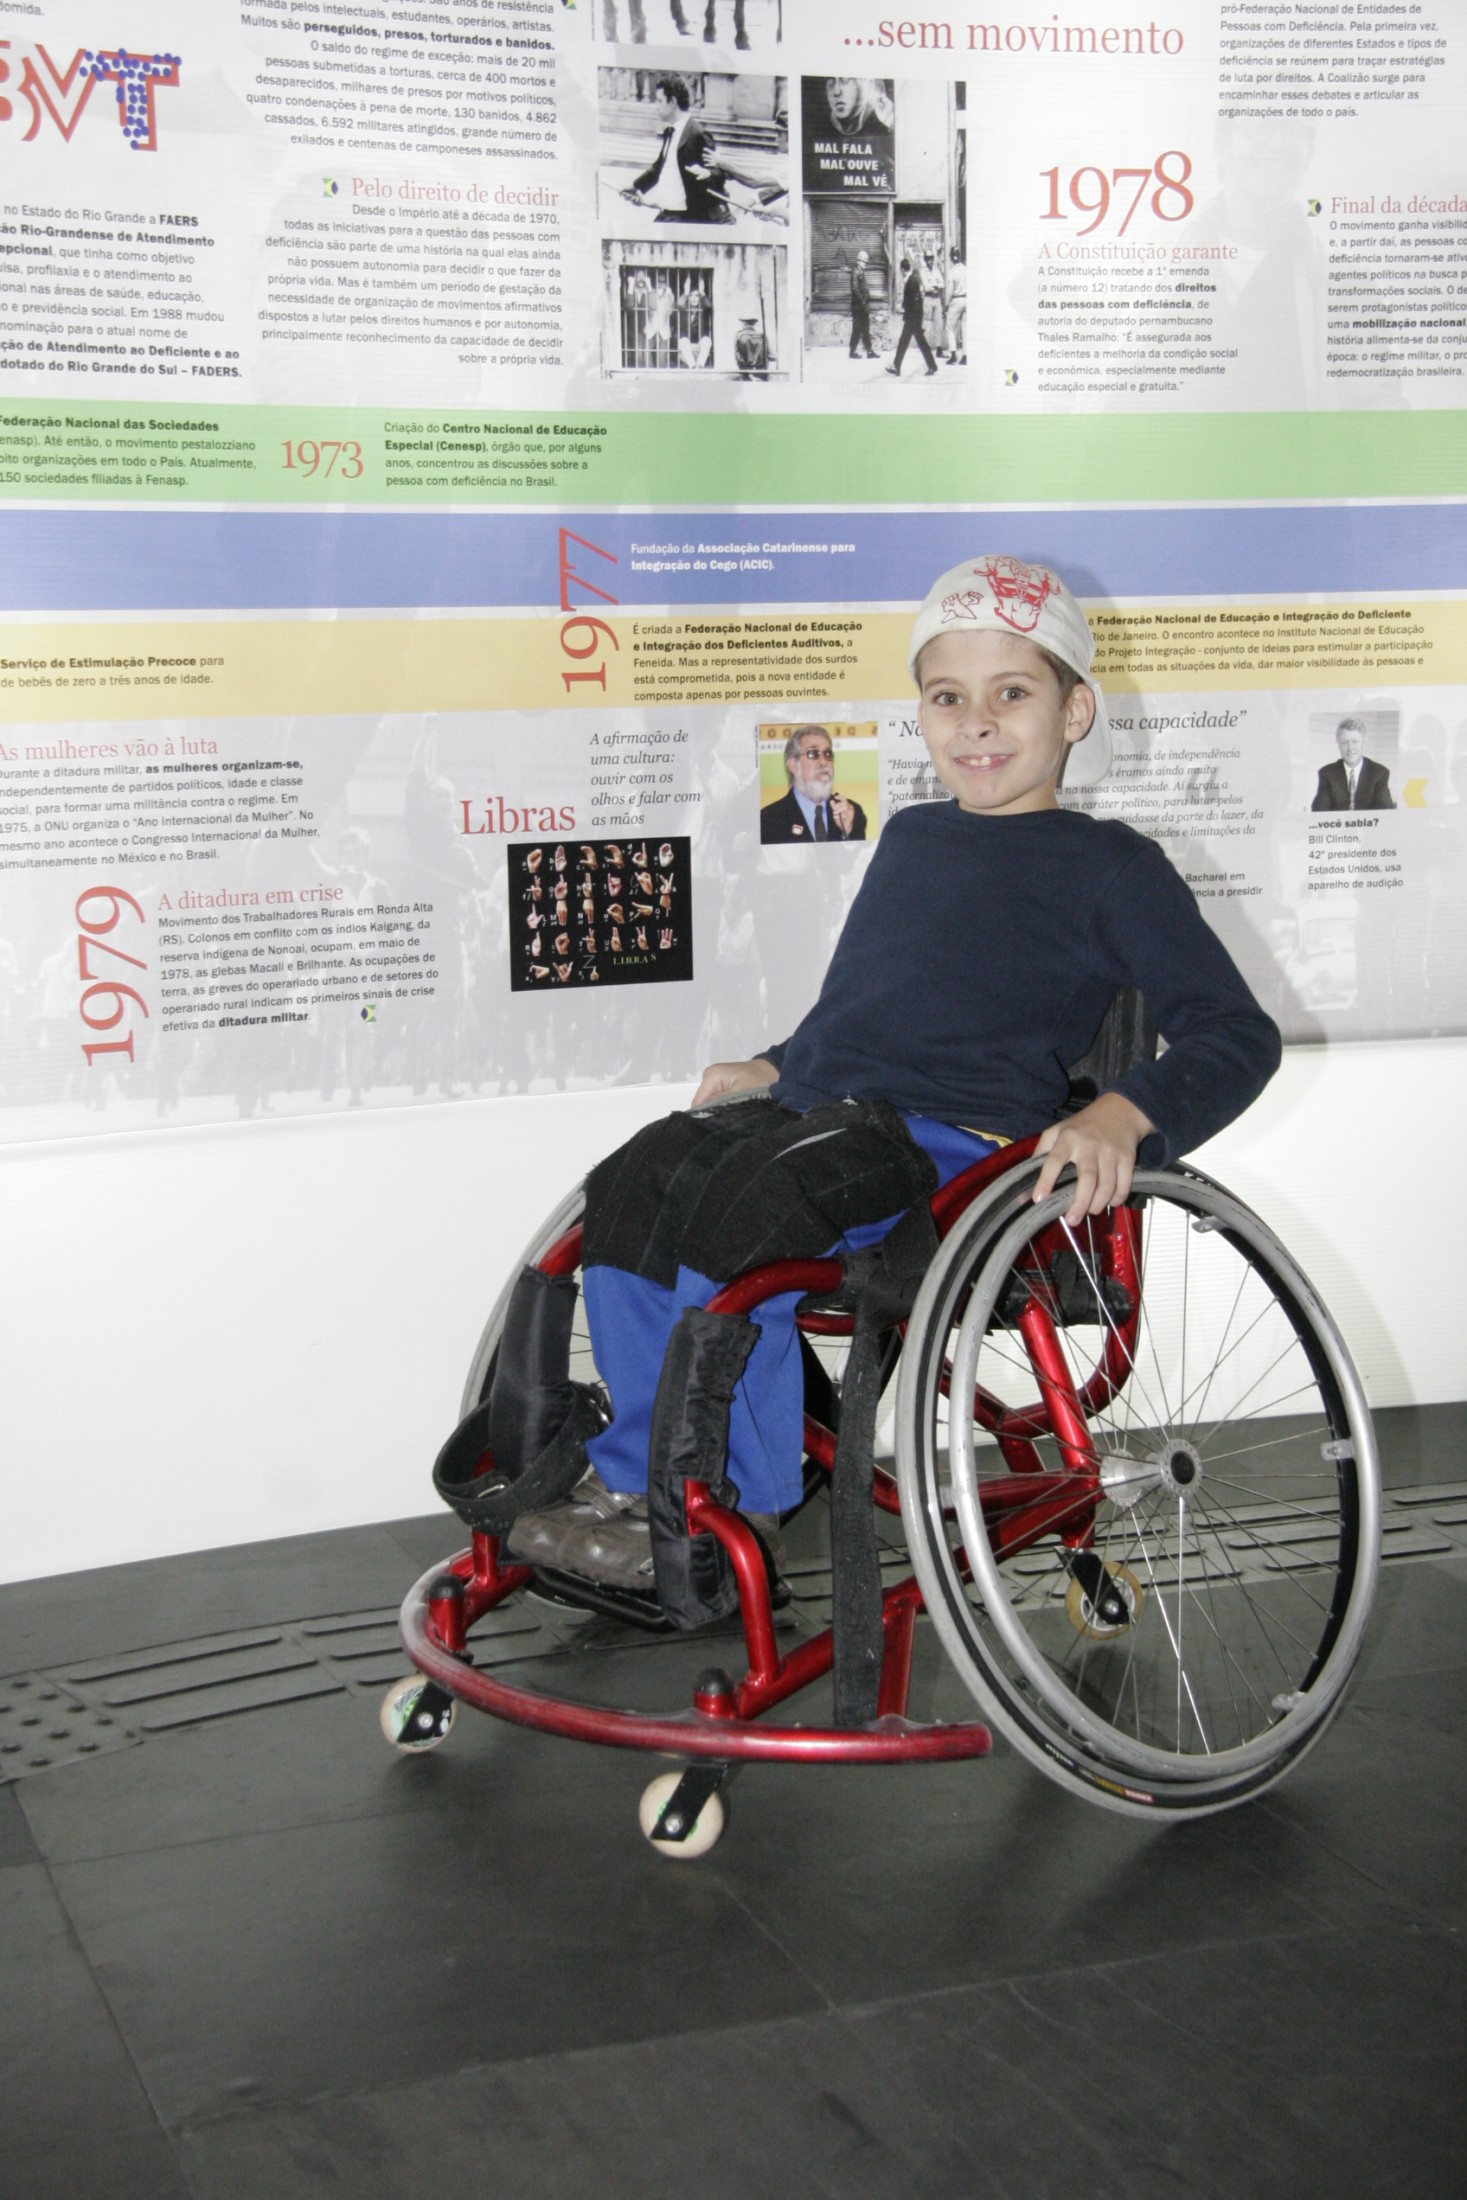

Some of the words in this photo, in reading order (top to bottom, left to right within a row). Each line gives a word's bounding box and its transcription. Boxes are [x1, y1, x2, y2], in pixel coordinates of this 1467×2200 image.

[1220, 2, 1292, 15] pró-Federação
[1294, 3, 1339, 14] Nacional
[1340, 3, 1354, 14] de
[1356, 3, 1406, 14] Entidades
[1408, 3, 1422, 14] de
[240, 13, 278, 28] Muitos
[280, 18, 300, 30] são
[303, 22, 381, 37] perseguidos,
[383, 29, 428, 41] presos,
[429, 31, 492, 45] torturados
[494, 38, 502, 46] e
[505, 36, 555, 50] banidos.
[1219, 20, 1262, 31] Pessoas
[1263, 22, 1286, 31] com
[1288, 20, 1346, 31] Deficiência.
[1349, 20, 1372, 31] Pela
[1374, 21, 1417, 32] primeira
[1419, 22, 1438, 31] vez,
[966, 15, 1184, 54] movimento
[814, 142, 839, 153] MAL
[842, 142, 873, 154] FALA
[819, 158, 845, 169] MAL
[846, 159, 879, 170] OUVE
[843, 174, 869, 186] MAL
[871, 173, 890, 188] VÊ
[351, 177, 392, 198] Pelo
[397, 179, 461, 201] direito
[466, 182, 488, 203] de
[493, 184, 559, 206] decidir
[1038, 150, 1195, 238] 1978
[1330, 195, 1375, 214] Final
[1380, 194, 1402, 213] da
[3, 205, 18, 215] no
[21, 204, 61, 218] Estado
[64, 208, 79, 219] do
[82, 208, 101, 220] Rio
[104, 210, 145, 223] Grande
[148, 215, 156, 224] a
[158, 213, 199, 227] FAERS
[1037, 242, 1051, 259] A
[1056, 241, 1167, 263] Constituição
[1170, 244, 1238, 264] garante
[47, 360, 64, 371] do
[67, 360, 88, 372] Rio
[91, 361, 136, 373] Grande
[139, 363, 155, 374] do
[157, 363, 177, 375] Sul
[191, 365, 242, 377] FADERS.
[1326, 367, 1414, 378] redemocratização
[1416, 366, 1464, 376] brasileira.
[64, 416, 120, 428] Nacional
[122, 418, 146, 429] das
[148, 419, 219, 431] Sociedades
[384, 421, 424, 434] Criação
[426, 423, 439, 432] do
[442, 422, 481, 433] Centro
[483, 423, 533, 434] Nacional
[535, 424, 550, 434] de
[552, 424, 607, 436] Educação
[384, 439, 433, 451] Especial
[491, 441, 521, 453] órgão
[523, 443, 546, 453] que,
[548, 443, 565, 453] por
[567, 442, 602, 454] alguns
[280, 440, 364, 478] 1973
[630, 543, 680, 555] Fundação
[681, 543, 695, 553] da
[697, 542, 760, 554] Associação
[761, 542, 828, 552] Catarinense
[830, 543, 855, 554] para
[631, 559, 691, 572] Integração
[692, 559, 708, 570] do
[709, 559, 738, 571] Cego
[739, 558, 775, 571] (ACIC).
[558, 527, 620, 693] 1977
[1096, 615, 1152, 625] Federação
[1154, 614, 1201, 624] Nacional
[1203, 613, 1217, 623] de
[1219, 612, 1270, 623] Educação
[1272, 613, 1280, 621] e
[1281, 610, 1339, 622] Integração
[1341, 610, 1355, 620] do
[1357, 609, 1411, 619] Deficiente
[632, 623, 639, 634] É
[641, 624, 672, 634] criada
[675, 626, 682, 634] a
[684, 623, 742, 634] Federação
[744, 622, 792, 632] Nacional
[794, 622, 808, 631] de
[810, 620, 863, 632] Educação
[0, 658, 47, 670] Serviço
[49, 658, 66, 668] de
[68, 656, 144, 668] Estimulação
[147, 656, 197, 666] Precoce
[199, 657, 224, 667] para
[591, 732, 600, 745] A
[602, 730, 670, 747] afirmação
[672, 728, 689, 742] de
[24, 739, 119, 760] mulheres
[123, 738, 159, 756] vão
[164, 736, 175, 756] à
[180, 736, 218, 755] luta
[590, 755, 620, 765] uma
[622, 750, 675, 764] cultura:
[590, 771, 626, 785] ouvir
[628, 774, 656, 784] com
[658, 773, 673, 783] os
[590, 791, 625, 806] olhos
[628, 795, 636, 804] e
[638, 790, 671, 807] falar
[673, 792, 701, 802] com
[459, 796, 576, 834] Libras
[590, 816, 606, 826] as
[609, 811, 644, 825] mãos
[1344, 817, 1379, 828] sabia?
[1308, 834, 1324, 844] Bill
[1325, 834, 1361, 845] Clinton,
[1327, 849, 1378, 860] presidente
[1379, 847, 1397, 857] dos
[1307, 865, 1345, 875] Estados
[1347, 863, 1382, 873] Unidos,
[1384, 863, 1402, 872] usa
[1307, 880, 1350, 891] aparelho
[1351, 879, 1364, 888] de
[1366, 877, 1404, 888] audição
[157, 892, 173, 910] A
[177, 888, 260, 909] ditadura
[264, 890, 294, 904] em
[299, 883, 343, 902] crise
[158, 916, 218, 927] Movimento
[221, 914, 241, 924] dos
[242, 910, 318, 922] Trabalhadores
[320, 907, 354, 917] Rurais
[356, 907, 374, 916] em
[376, 904, 410, 914] Ronda
[412, 902, 433, 912] Alta
[75, 885, 150, 1067] 1979
[162, 1021, 199, 1031] efetiva
[201, 1019, 215, 1028] da
[217, 1015, 268, 1027] ditadura
[270, 1012, 312, 1023] militar.
